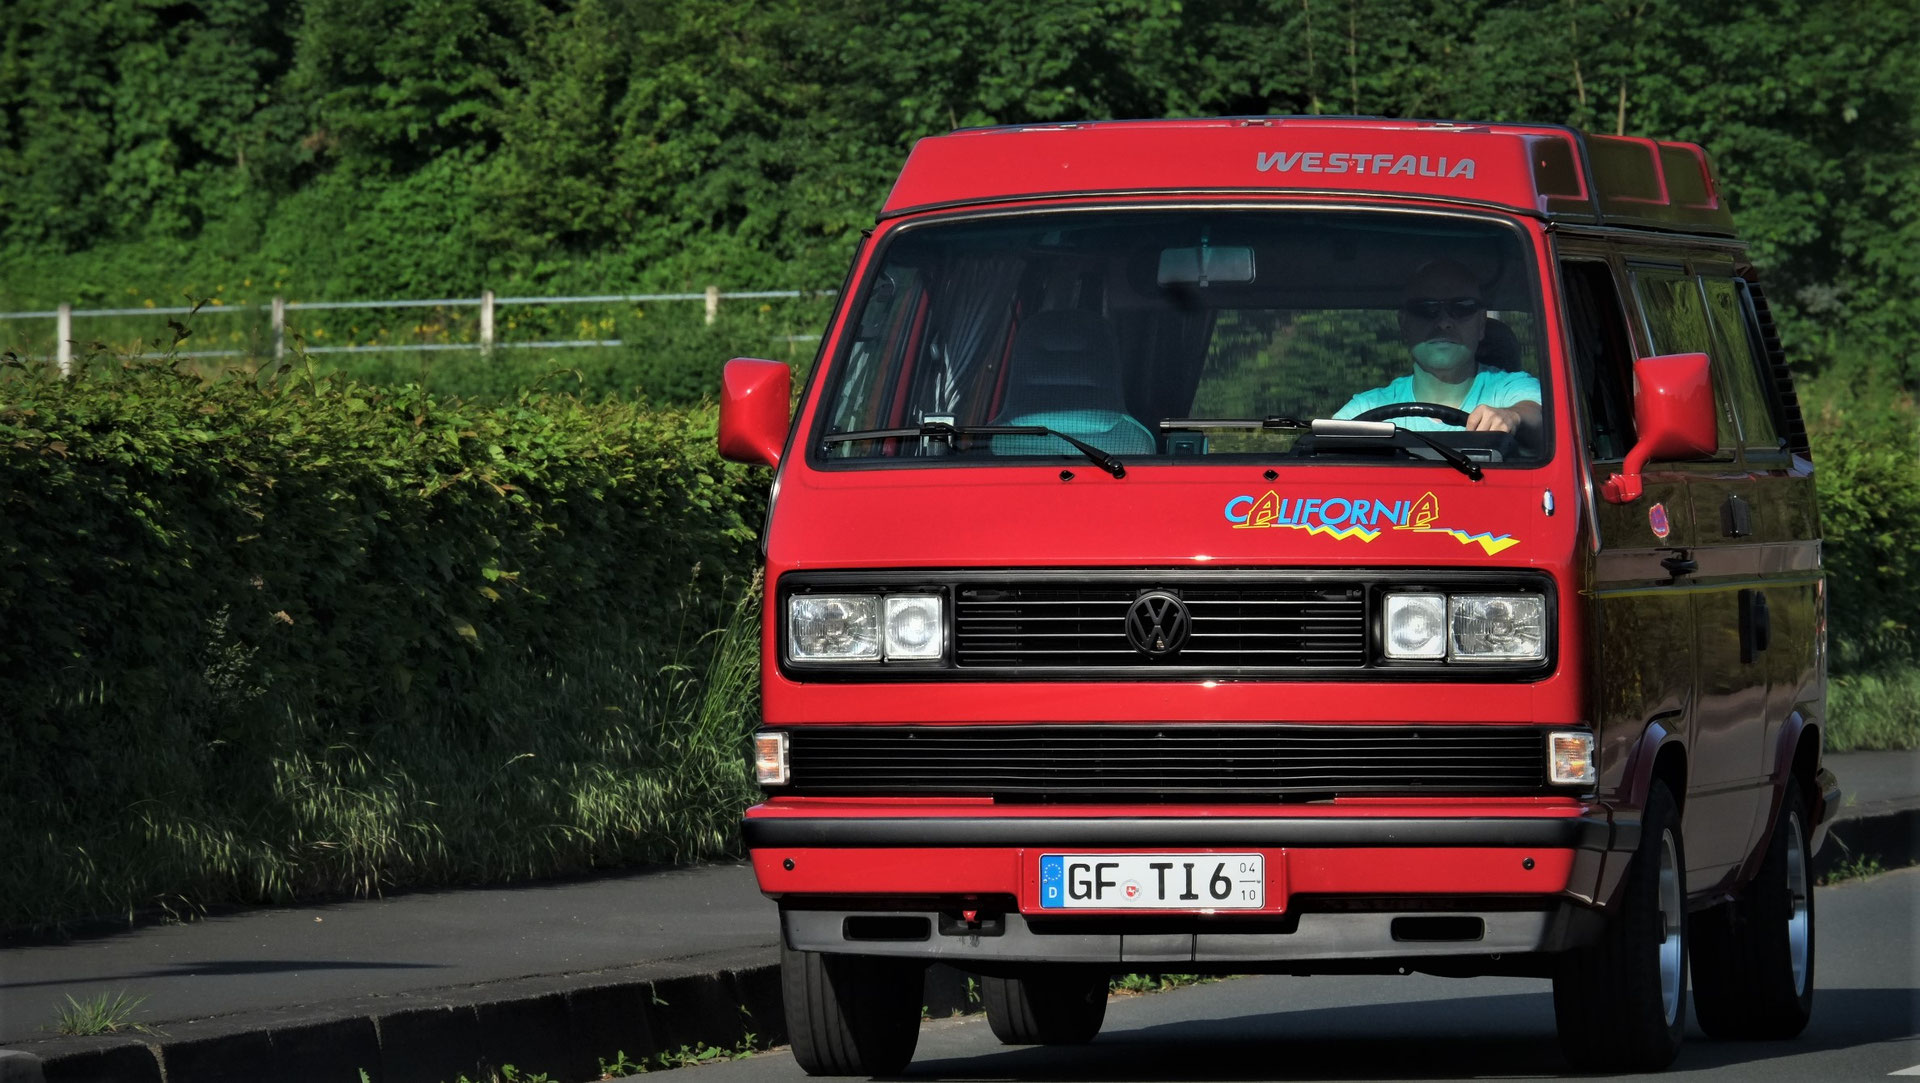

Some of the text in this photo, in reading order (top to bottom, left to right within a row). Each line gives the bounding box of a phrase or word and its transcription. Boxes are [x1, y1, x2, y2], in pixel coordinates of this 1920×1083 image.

[1256, 152, 1475, 179] WESTFALIA
[1224, 490, 1439, 528] CALIFORNIA
[1128, 595, 1187, 654] VW
[1068, 863, 1119, 900] GF
[1239, 862, 1255, 874] 04
[1048, 886, 1058, 899] D
[1241, 889, 1256, 901] 10
